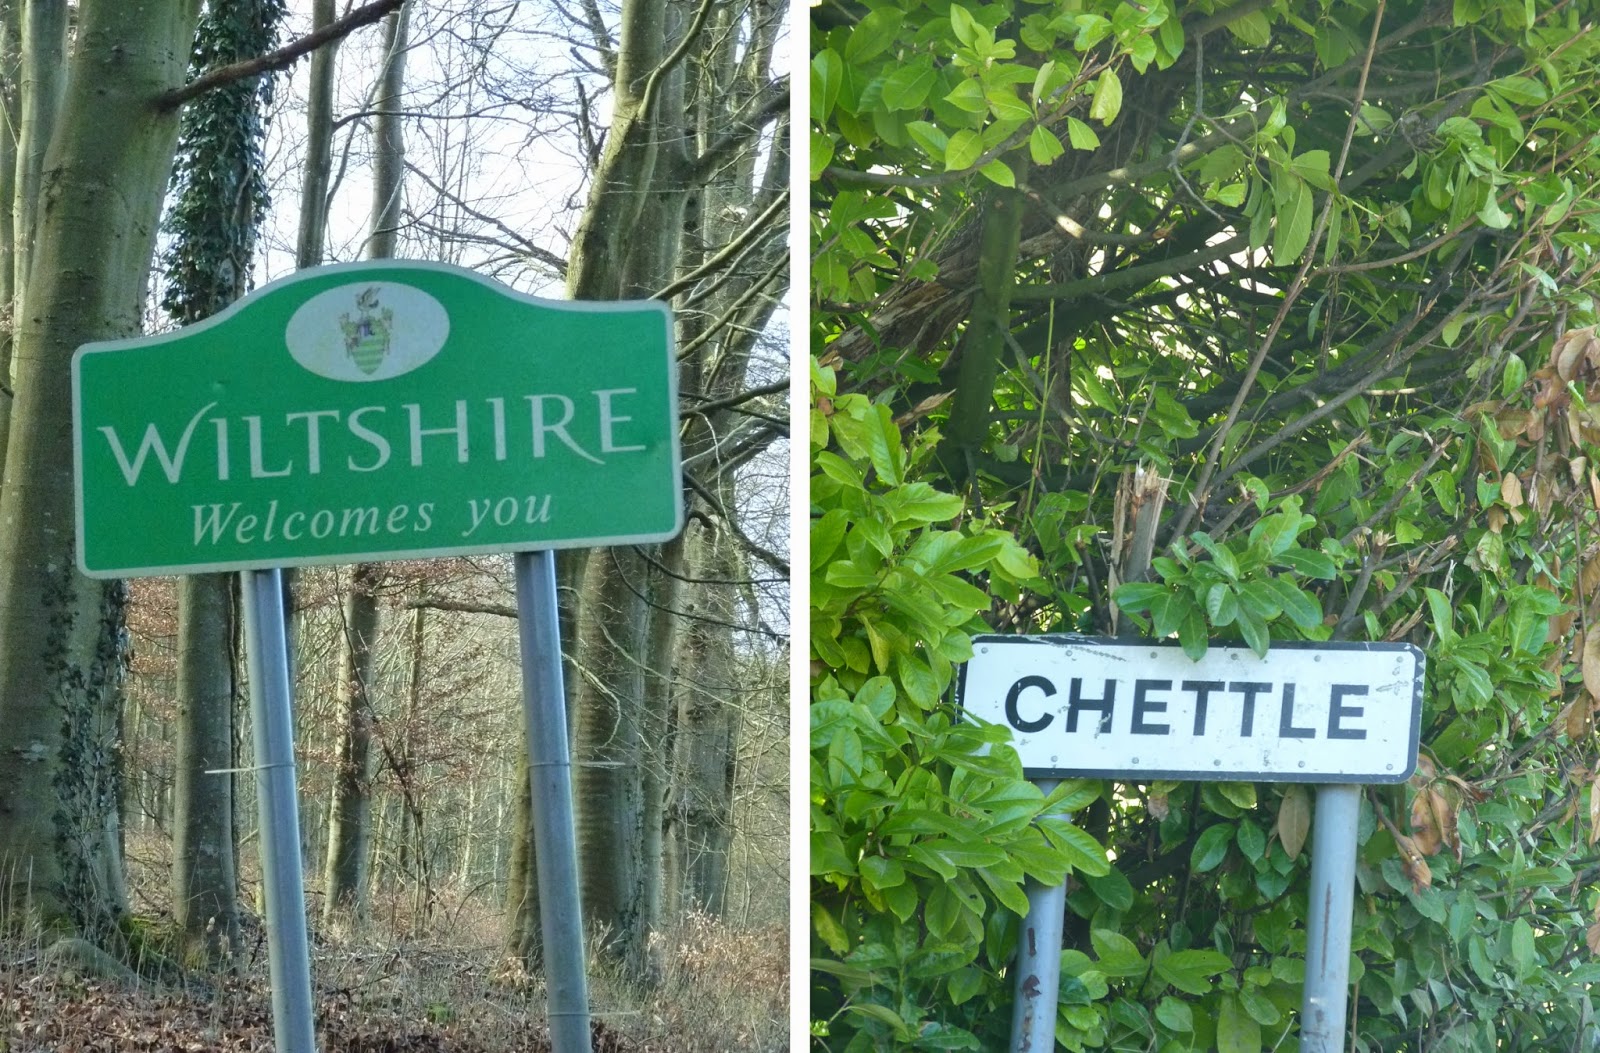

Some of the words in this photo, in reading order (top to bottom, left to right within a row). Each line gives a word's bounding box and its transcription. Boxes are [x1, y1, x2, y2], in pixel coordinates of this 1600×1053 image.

[97, 387, 646, 487] WILTSHIRE
[191, 499, 434, 546] Welcomes
[462, 492, 552, 536] you
[1004, 675, 1369, 740] CHETTLE
